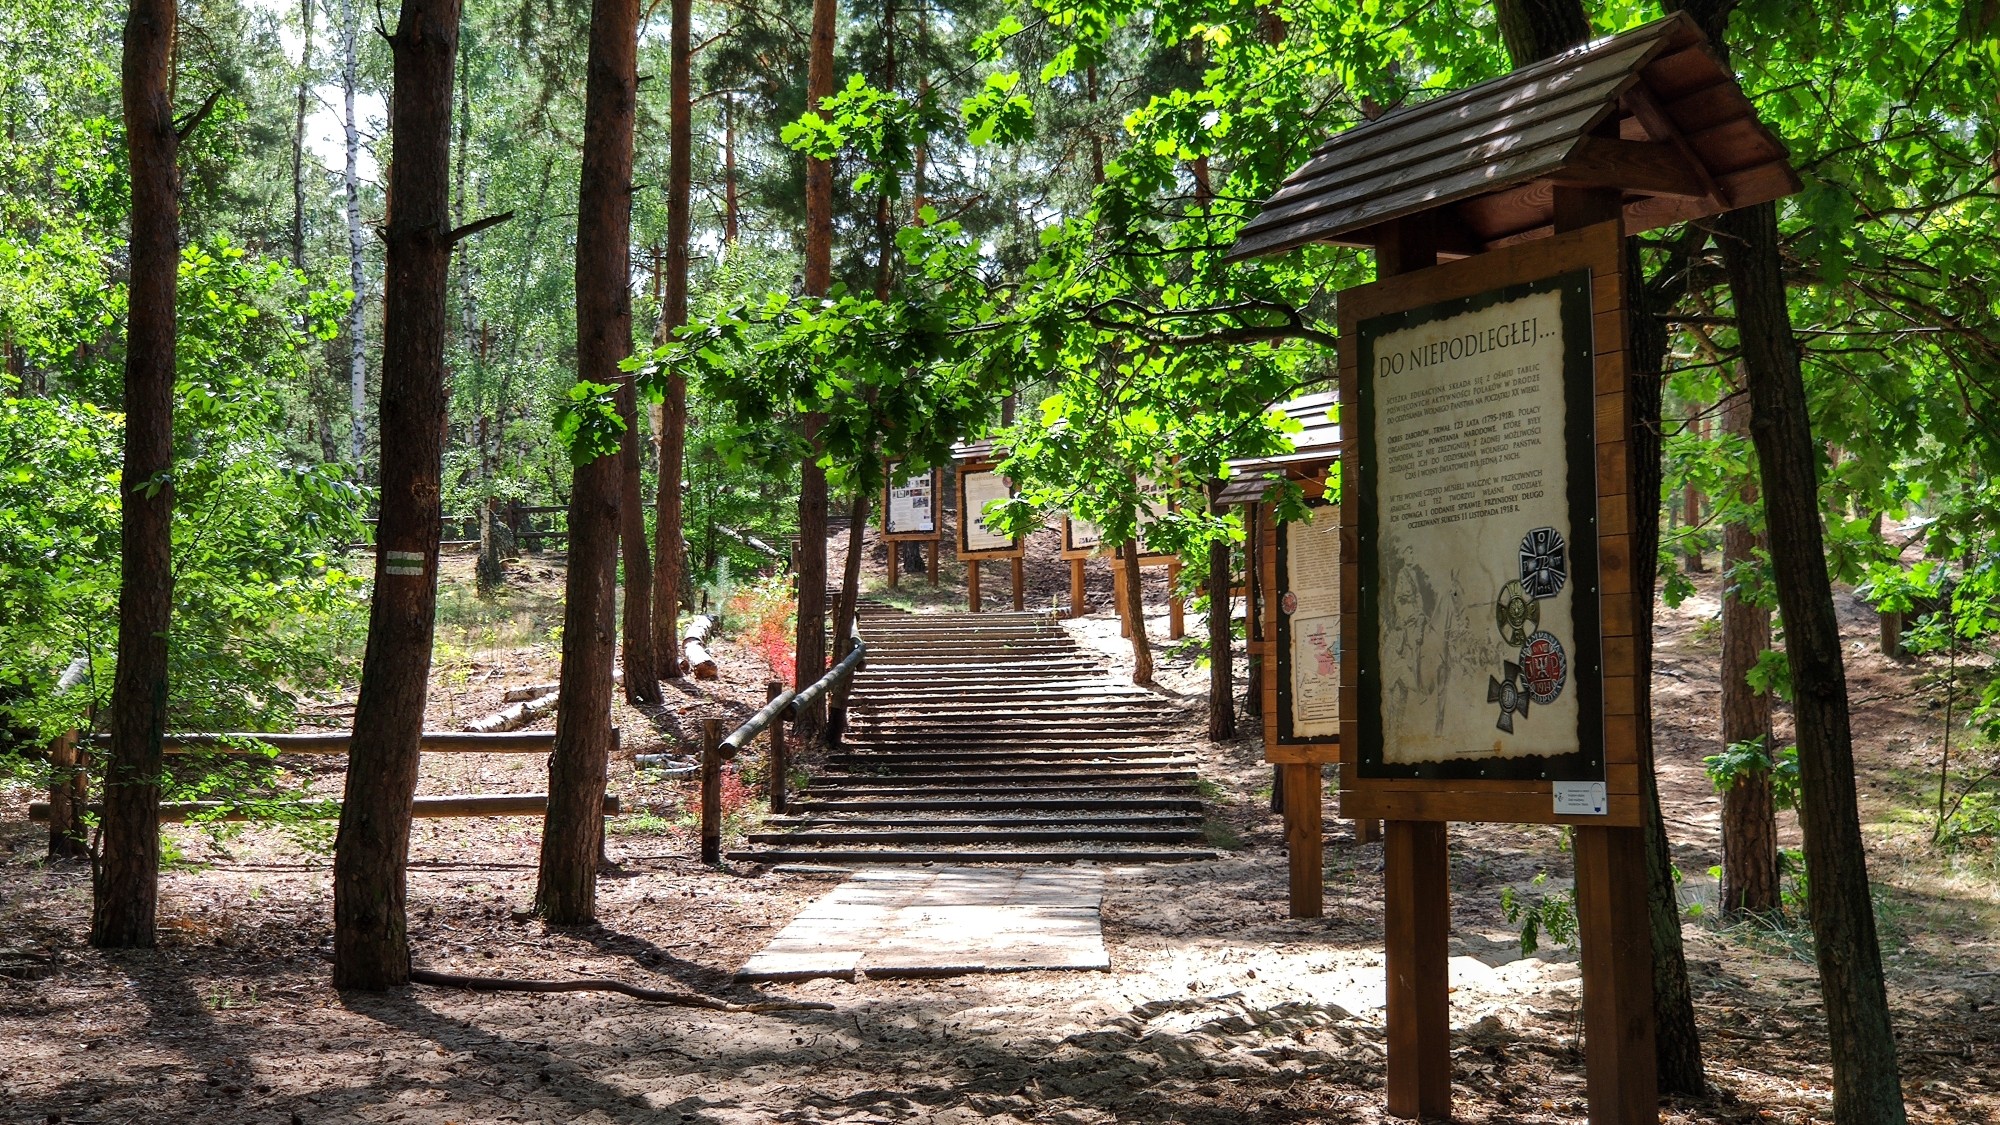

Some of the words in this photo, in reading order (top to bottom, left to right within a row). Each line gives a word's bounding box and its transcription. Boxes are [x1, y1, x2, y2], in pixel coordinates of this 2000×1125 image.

[1380, 352, 1404, 378] DO
[1410, 317, 1556, 371] NIEPODLEGŁEJ...
[1474, 376, 1483, 386] SIĘ
[1518, 363, 1540, 375] TABLIC
[1513, 373, 1540, 386] DRODZE
[1512, 388, 1519, 397] XX
[1454, 420, 1463, 430] 123
[1466, 418, 1480, 427] LATA
[1518, 404, 1541, 416] POLACY
[1428, 432, 1459, 445] POWSTANIA
[1503, 418, 1521, 430] KTÓRE
[1527, 416, 1541, 425] BYŁY
[1443, 450, 1476, 462] ODZYSKANIA
[1480, 443, 1509, 455] WOLNEGO
[1479, 456, 1498, 468] JEDNĄ
[1423, 487, 1443, 497] CZĘSTO
[1443, 483, 1464, 493] MUSIELI
[1501, 468, 1543, 483] PRZECIWNYCH
[1430, 505, 1455, 515] ODDANIE
[1458, 500, 1481, 511] SPRAWIE
[1484, 494, 1518, 506] PRZYNIOSŁY
[1521, 490, 1544, 500] DŁUGO
[1441, 514, 1460, 524] SUKCES
[1461, 512, 1467, 520] 11
[1468, 507, 1499, 519] LISTOPADA
[1500, 504, 1515, 514] 1918
